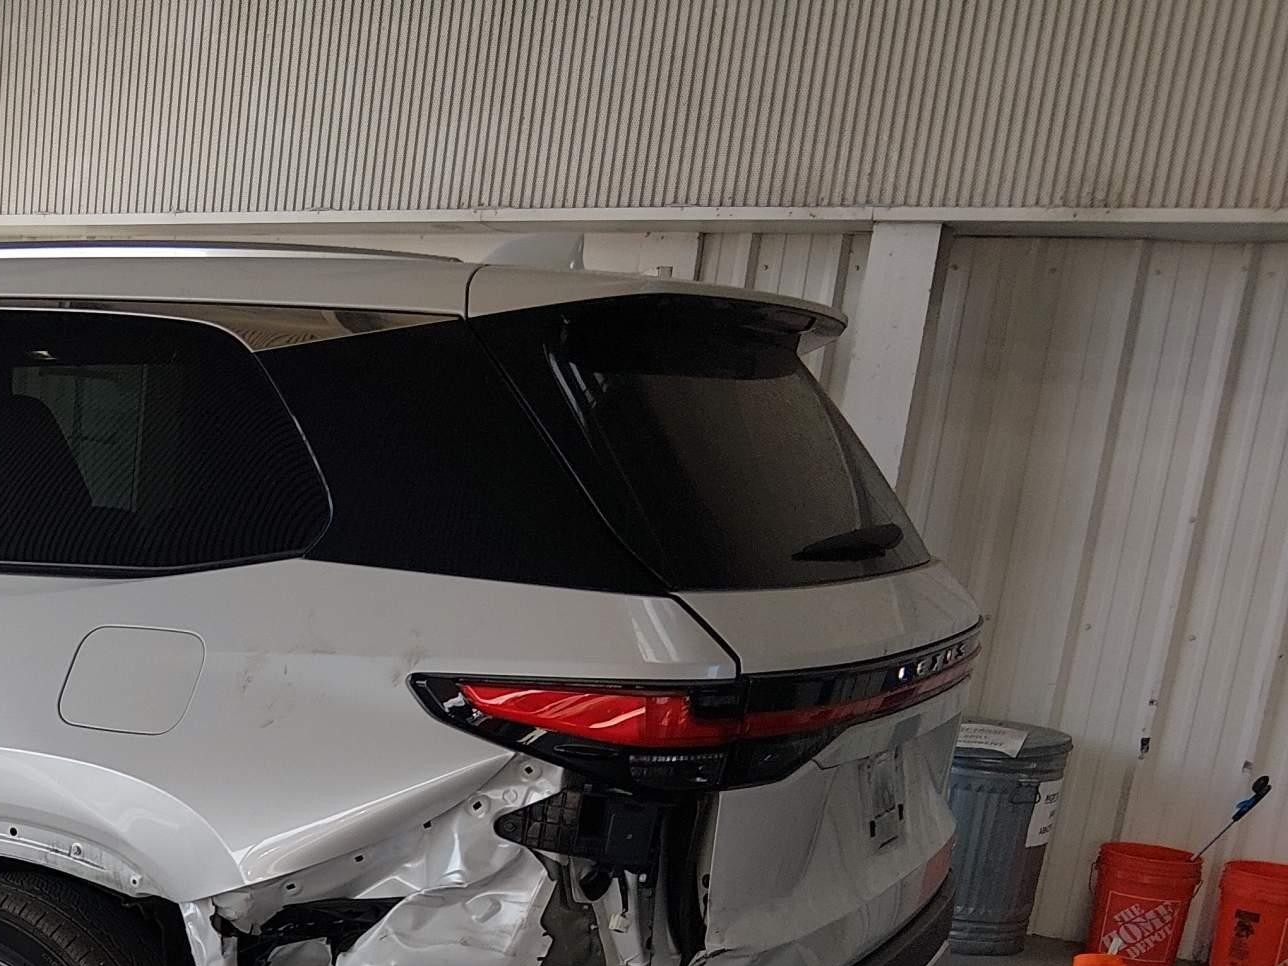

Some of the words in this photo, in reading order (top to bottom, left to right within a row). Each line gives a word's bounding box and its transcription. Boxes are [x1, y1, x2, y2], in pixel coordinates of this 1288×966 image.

[898, 643, 968, 681] LEXUS
[1112, 903, 1144, 925] THE
[1125, 924, 1172, 959] DEPOT
